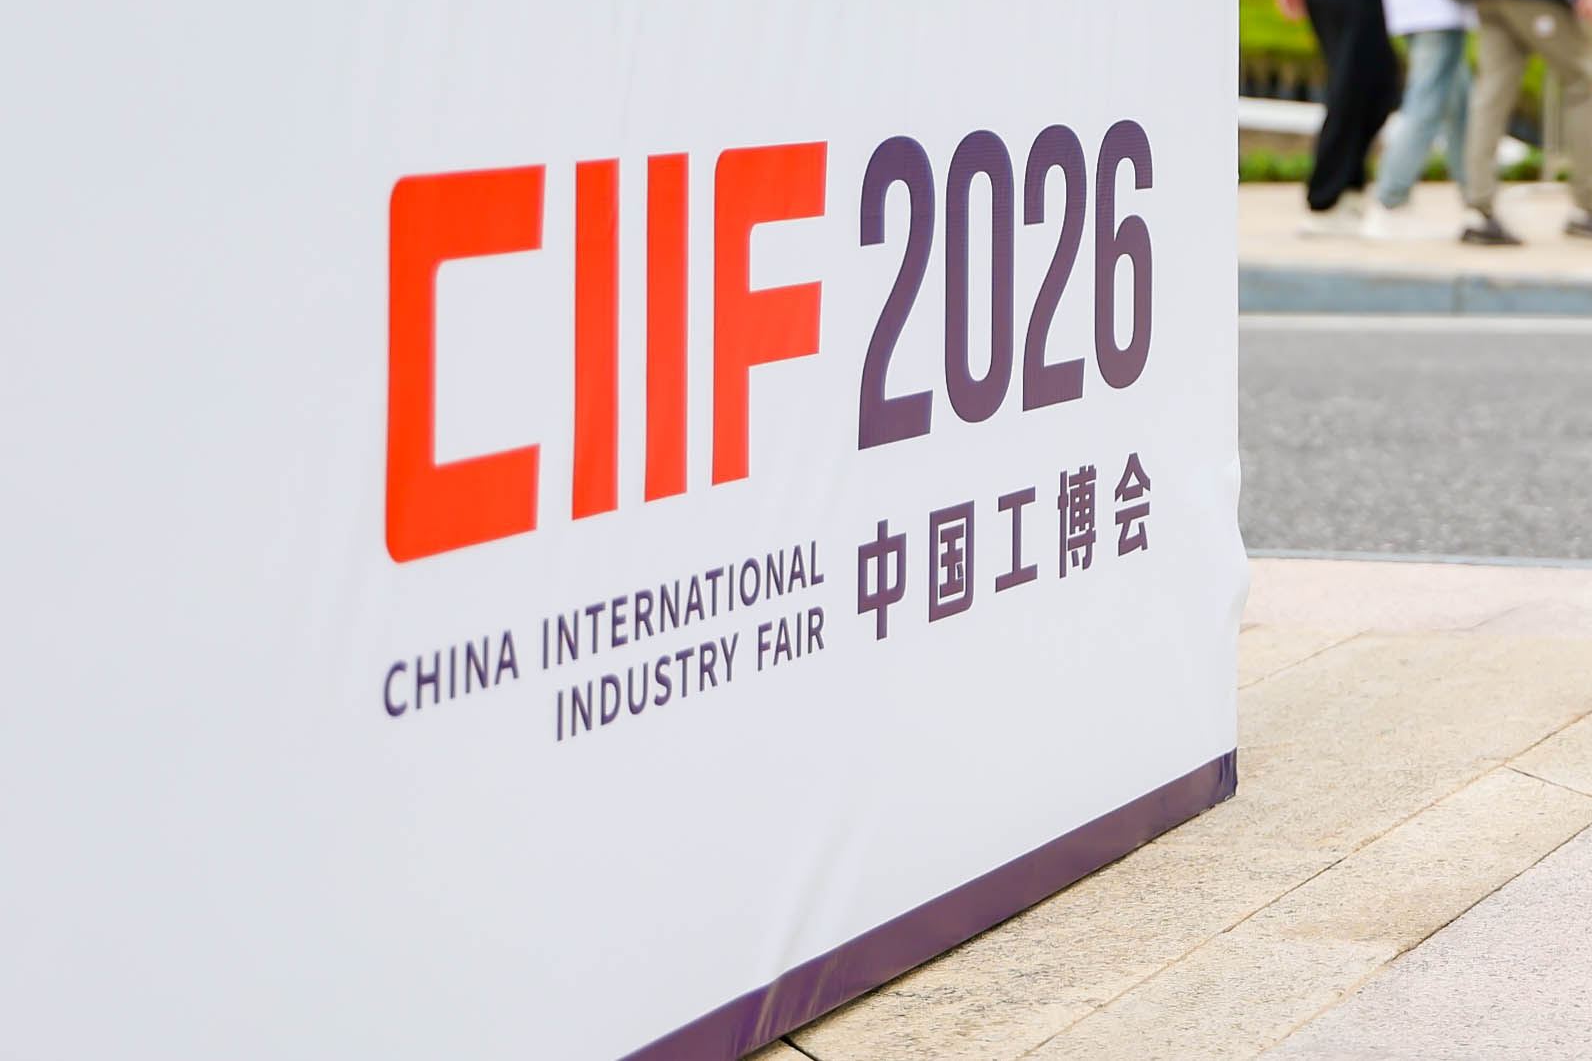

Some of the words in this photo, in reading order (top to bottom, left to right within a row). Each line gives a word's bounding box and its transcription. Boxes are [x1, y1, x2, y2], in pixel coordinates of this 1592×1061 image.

[383, 140, 828, 564] CIIF
[857, 118, 1154, 451] 2026
[382, 628, 521, 720] CHINA
[540, 540, 826, 672] INTERNATIONAL
[856, 451, 1153, 642] 中国工博会
[554, 636, 739, 743] INDUSTRY
[756, 606, 827, 674] FAIR
